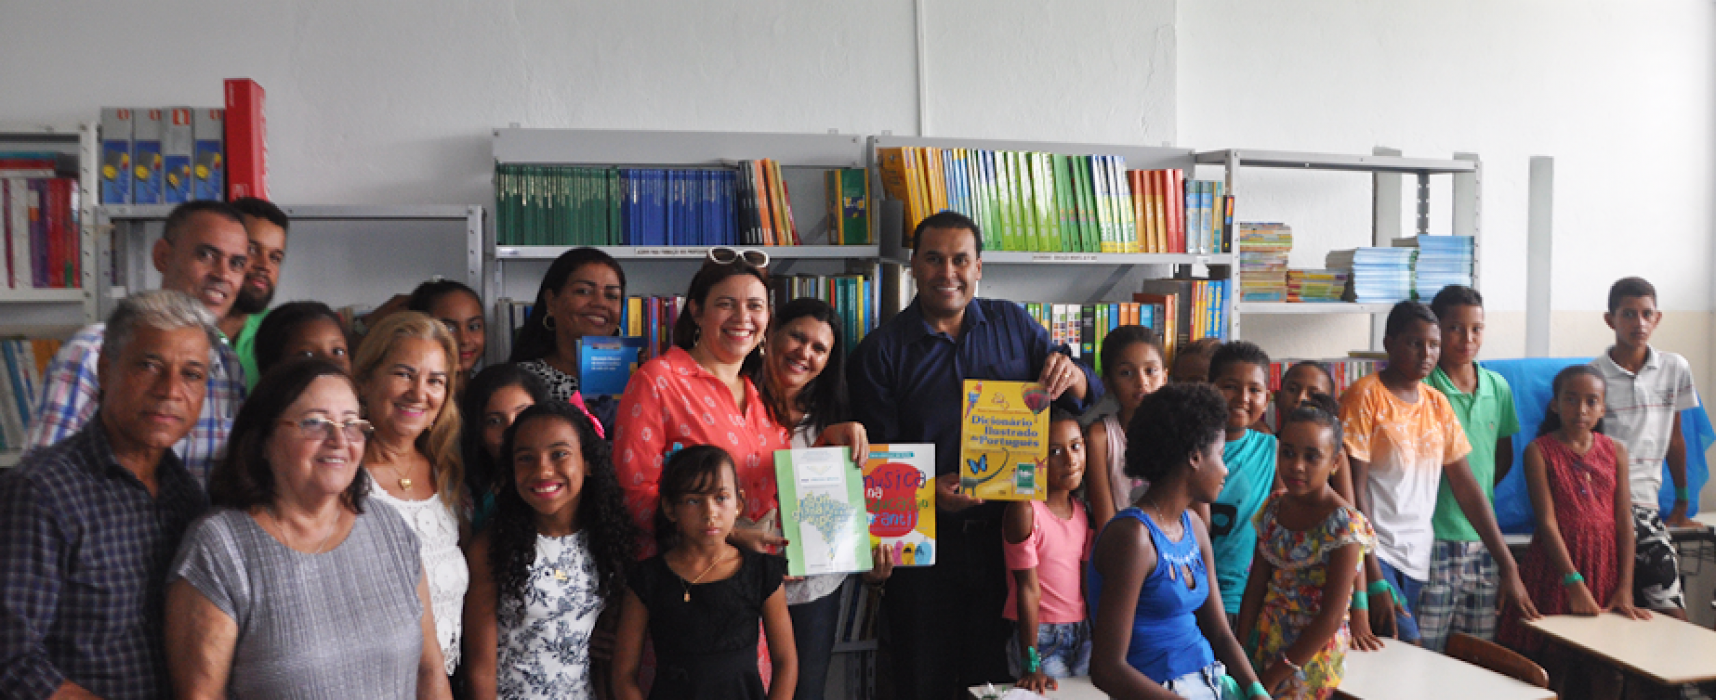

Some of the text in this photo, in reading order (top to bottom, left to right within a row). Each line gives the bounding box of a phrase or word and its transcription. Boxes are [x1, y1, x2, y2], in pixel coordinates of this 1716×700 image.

[971, 415, 1033, 427] Dicionário
[985, 425, 1039, 438] Ilustrado
[979, 435, 1040, 448] Português
[866, 486, 884, 500] na
